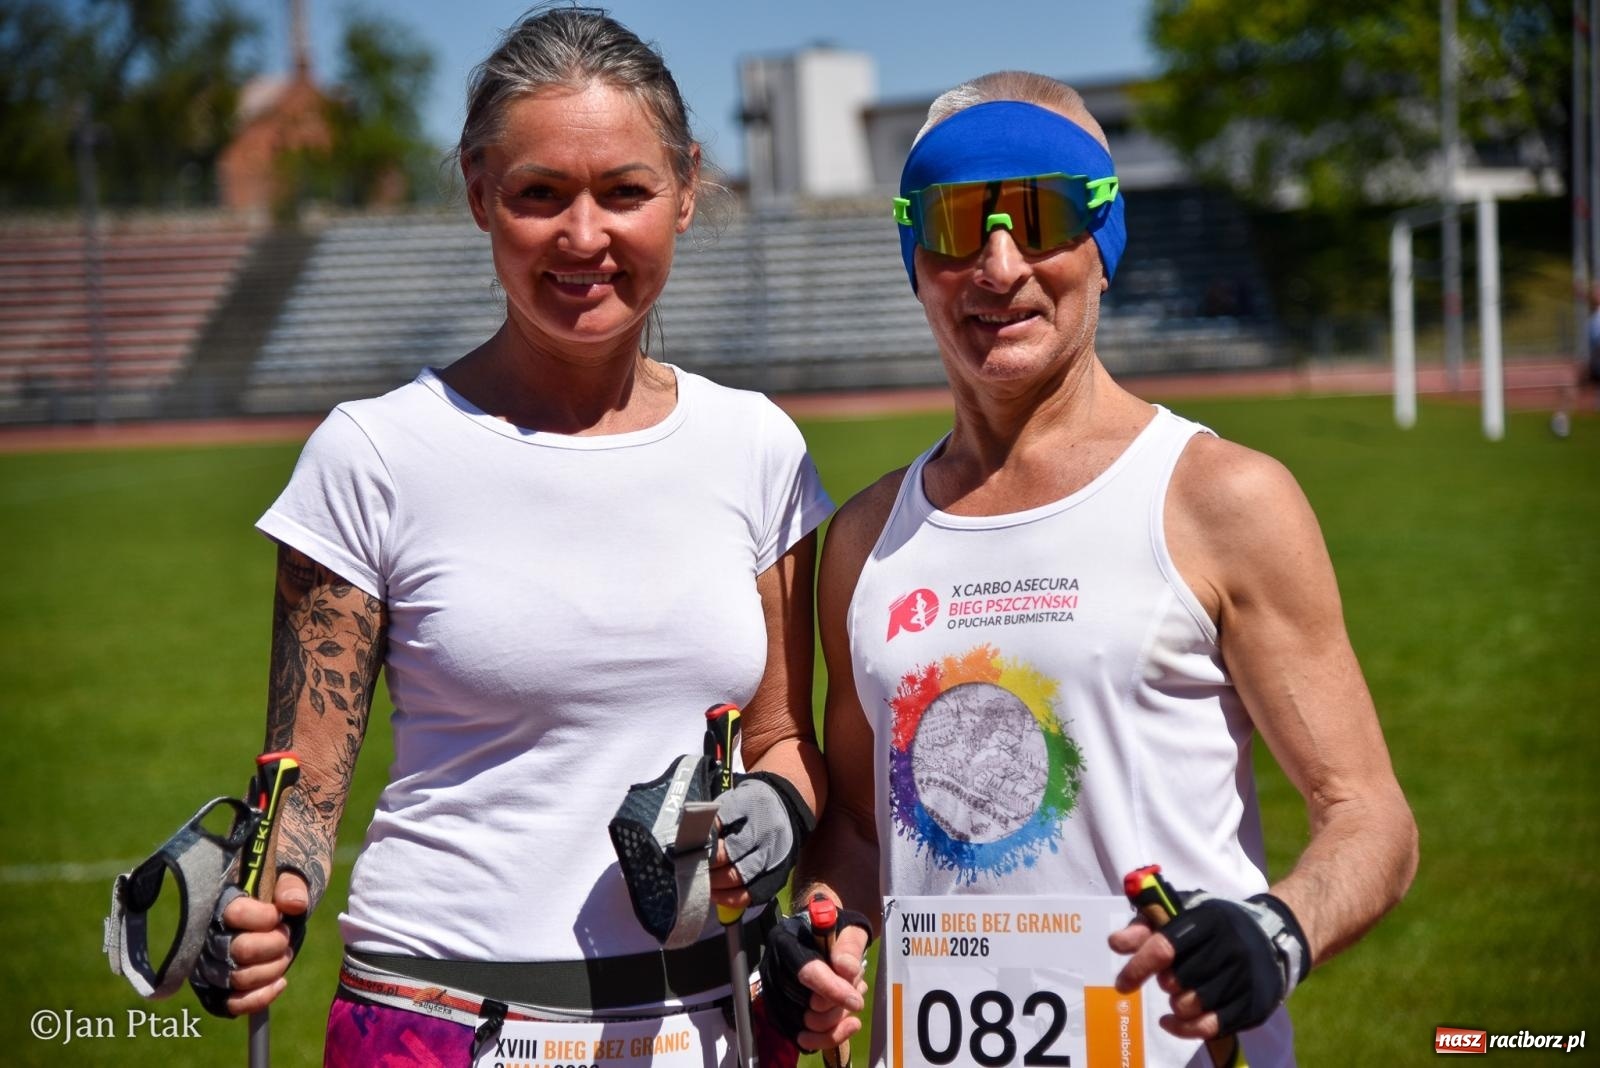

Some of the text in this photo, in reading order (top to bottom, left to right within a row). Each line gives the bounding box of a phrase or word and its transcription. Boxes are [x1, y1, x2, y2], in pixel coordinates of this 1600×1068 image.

[951, 578, 1080, 598] X CARBO ASECURA
[949, 592, 1078, 616] BIEG PSZCZYŃSKI
[947, 612, 1075, 630] O PUCHAR BURMISTRZA
[664, 767, 690, 813] LEKI
[248, 820, 271, 871] LEKI
[901, 913, 1082, 933] XVIII BIEG BEZ GRANIC
[902, 937, 990, 957] 3MAJA2026
[917, 989, 1071, 1068] 082
[494, 1031, 690, 1060] XVIII BIEG BEZ GRANIC
